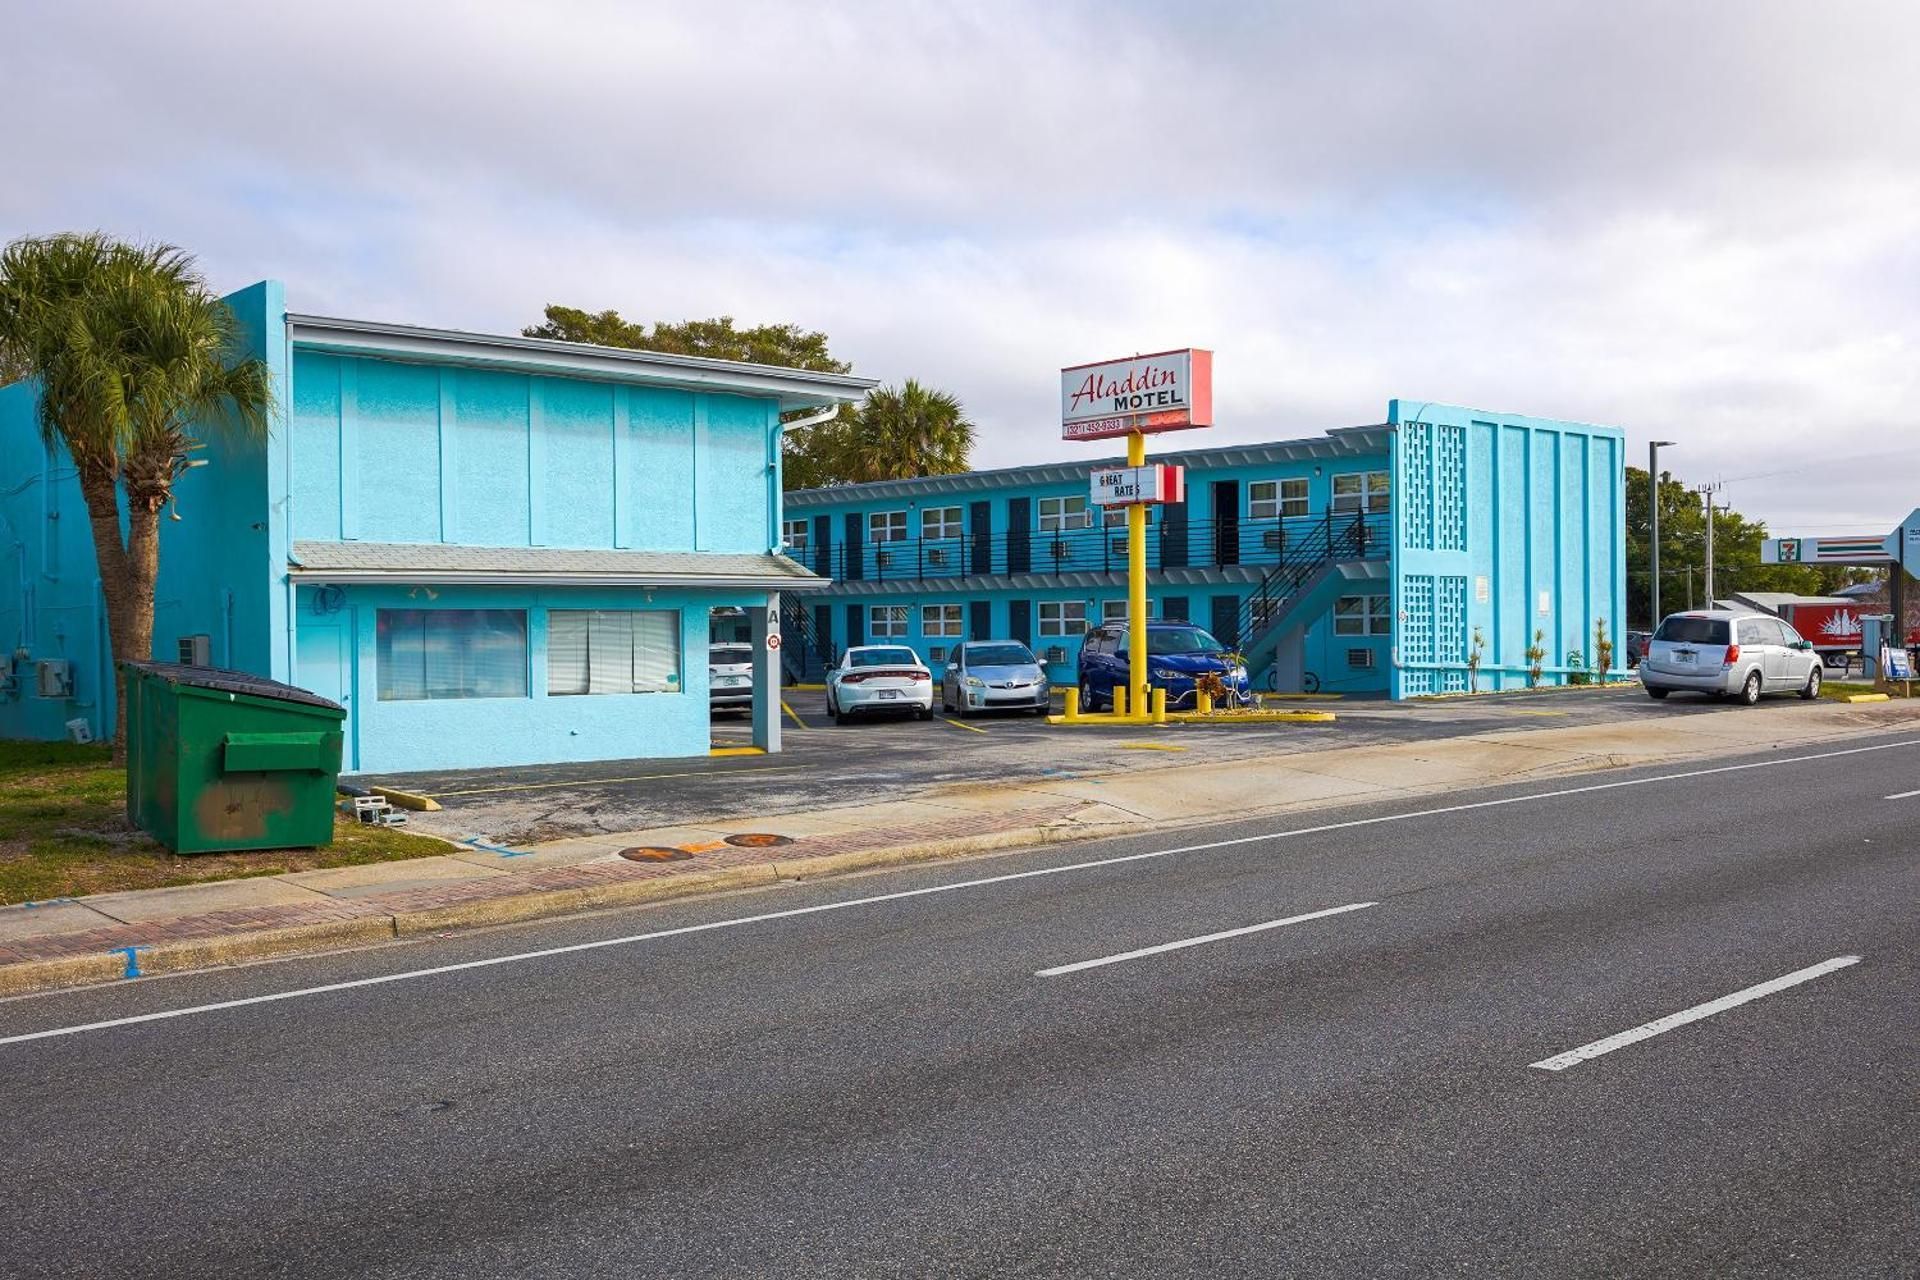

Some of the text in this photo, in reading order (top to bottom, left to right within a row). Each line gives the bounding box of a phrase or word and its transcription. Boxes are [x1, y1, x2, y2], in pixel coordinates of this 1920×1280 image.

[1071, 365, 1176, 412] Aladdin
[1114, 389, 1183, 411] MOTEL
[1100, 474, 1123, 486] GREAT
[767, 610, 779, 624] A
